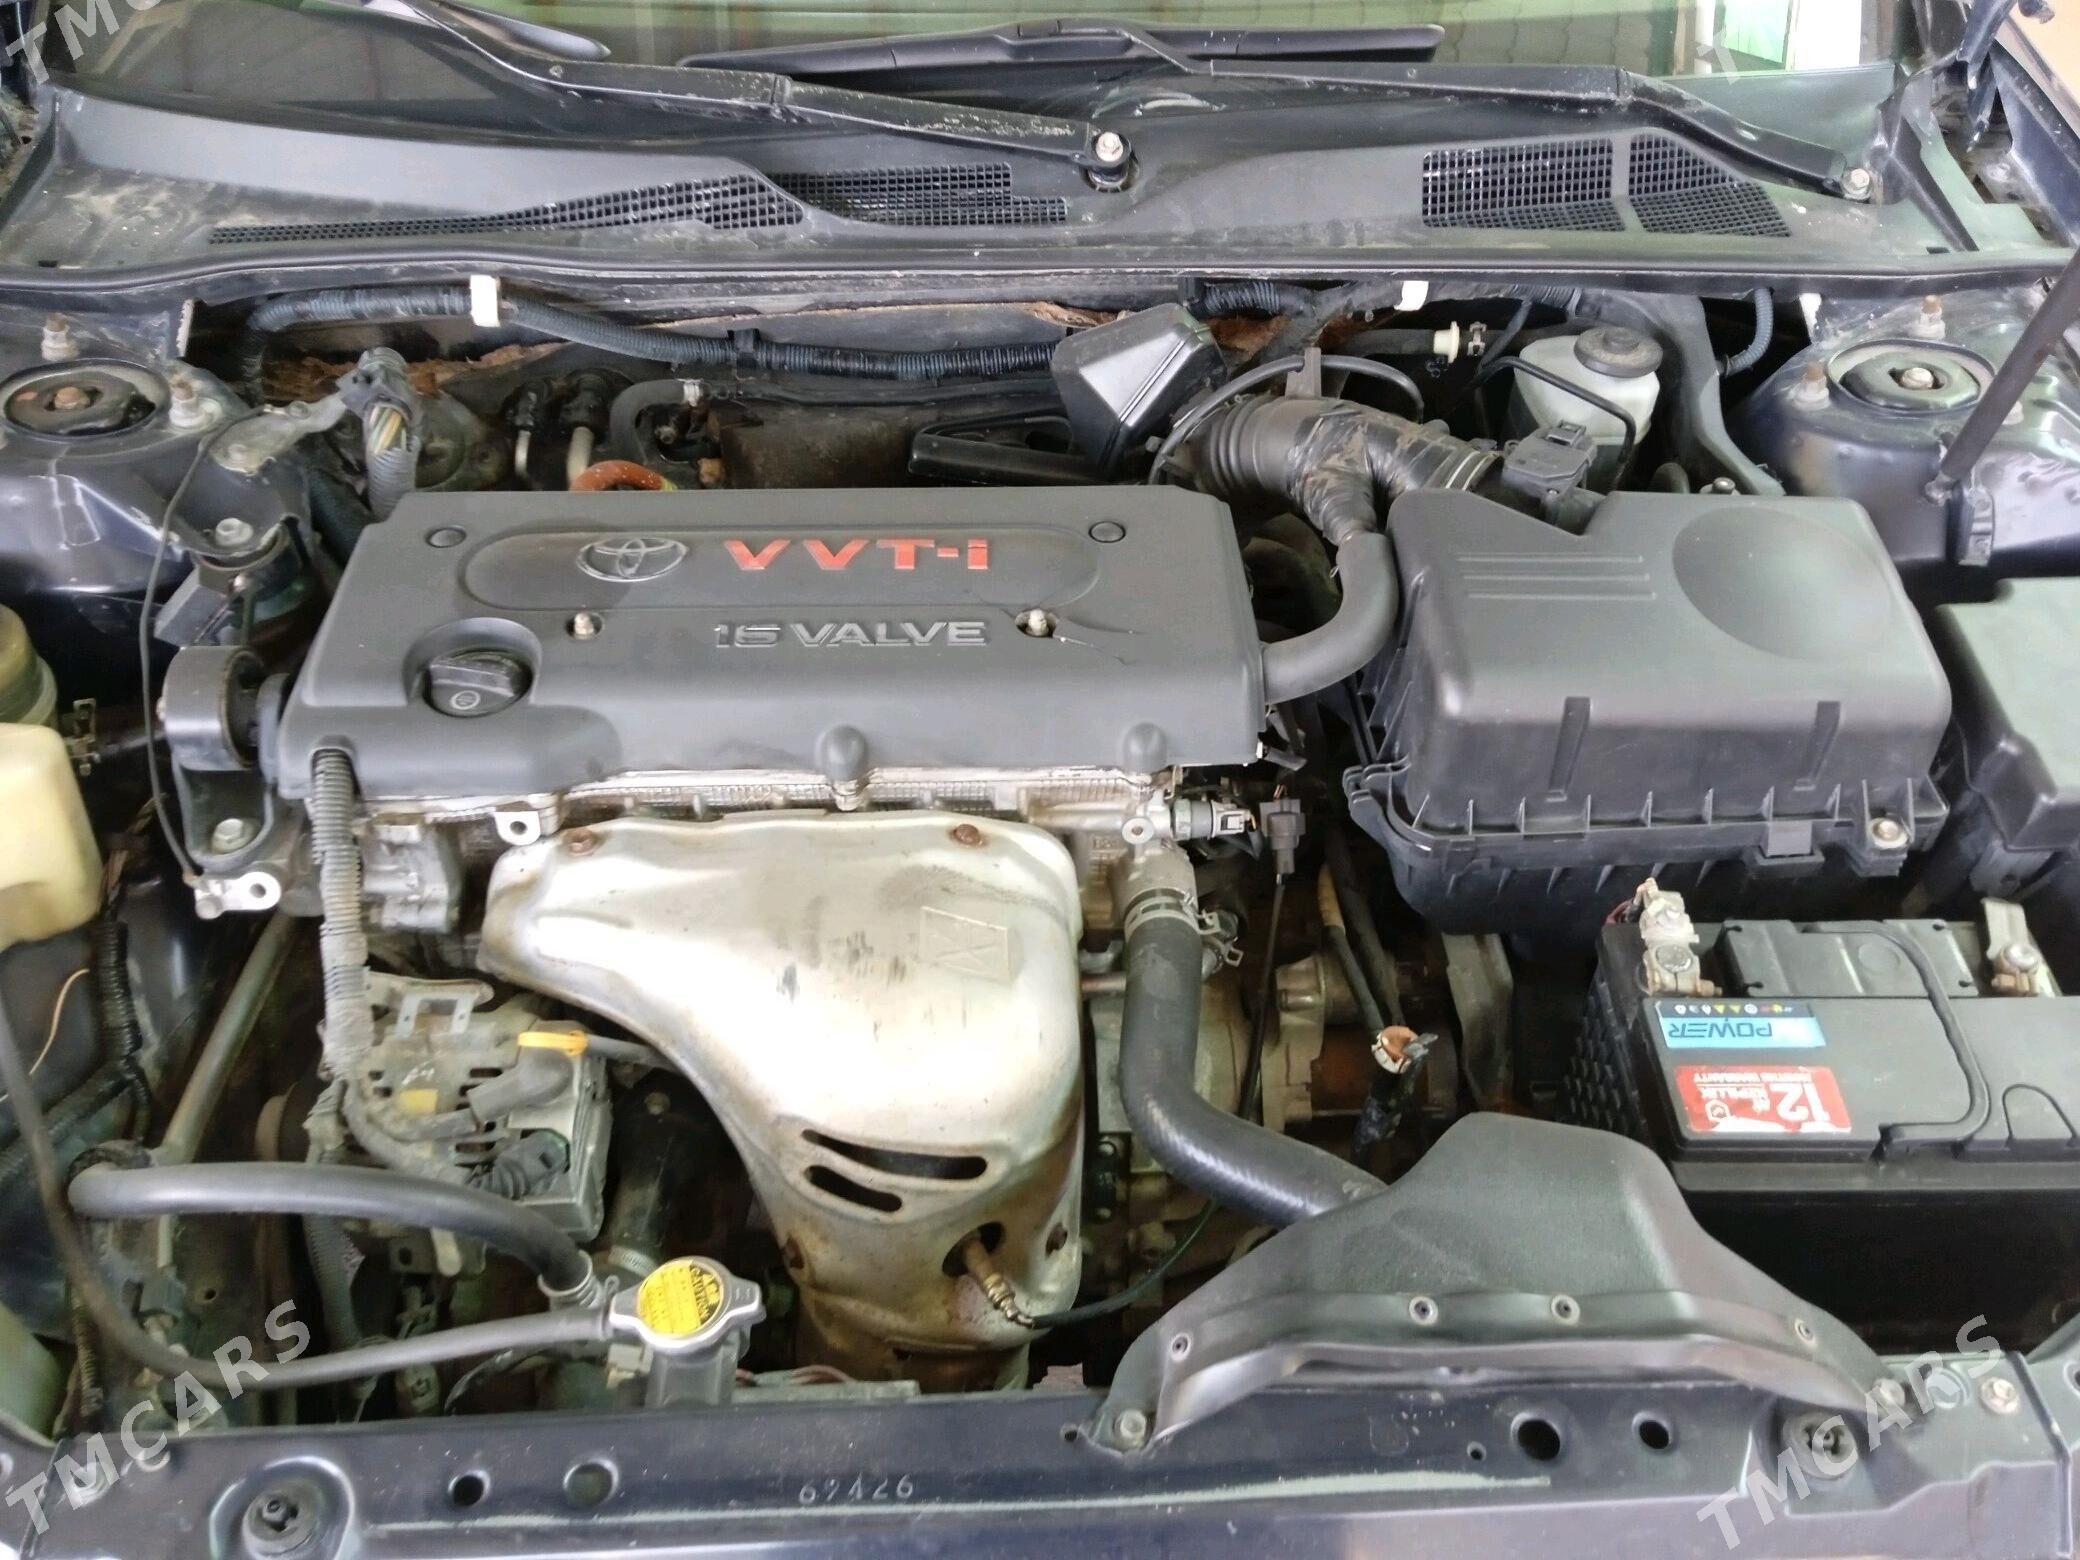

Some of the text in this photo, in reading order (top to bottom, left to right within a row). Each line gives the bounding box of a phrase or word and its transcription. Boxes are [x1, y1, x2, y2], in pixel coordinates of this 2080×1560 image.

[714, 621, 988, 648] 16 VALVE
[1668, 1021, 1773, 1038] POWER
[1769, 1083, 1831, 1122] 12
